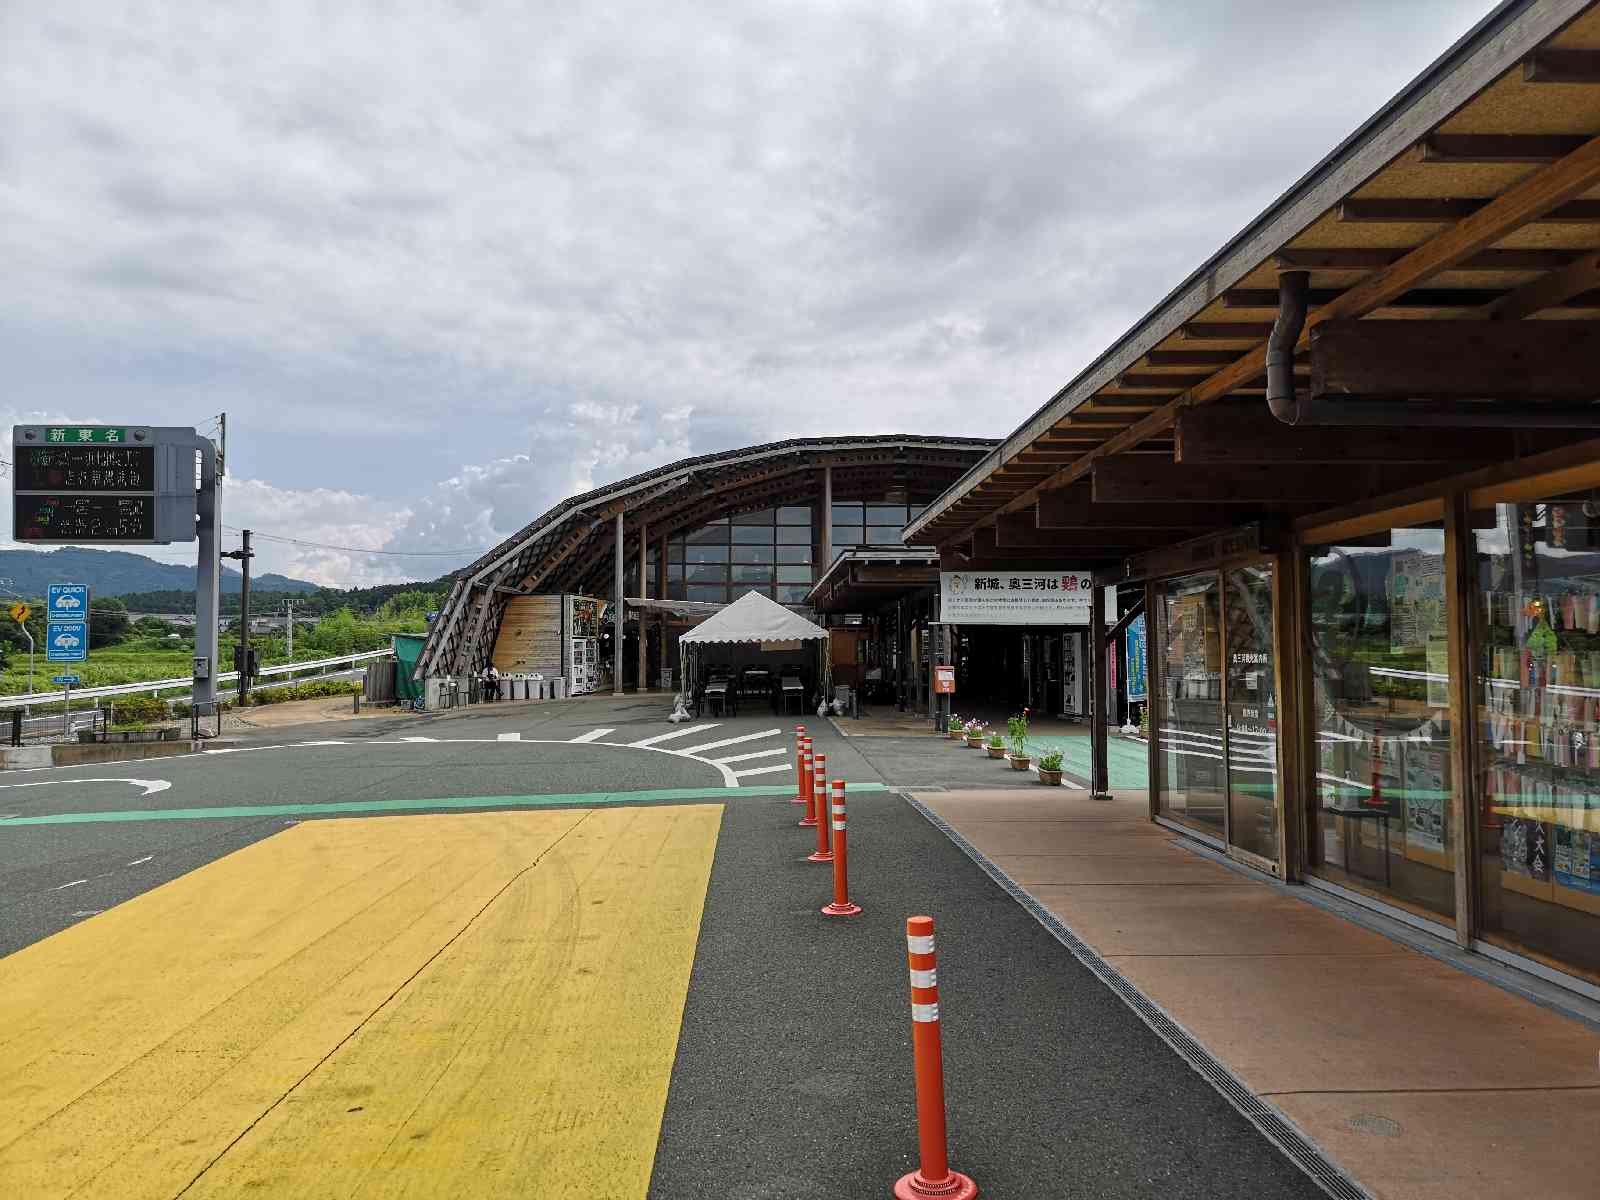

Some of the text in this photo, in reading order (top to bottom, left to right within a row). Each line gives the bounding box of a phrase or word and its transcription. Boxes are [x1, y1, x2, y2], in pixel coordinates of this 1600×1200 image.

[51, 429, 120, 442] 新東名
[51, 586, 61, 594] EV
